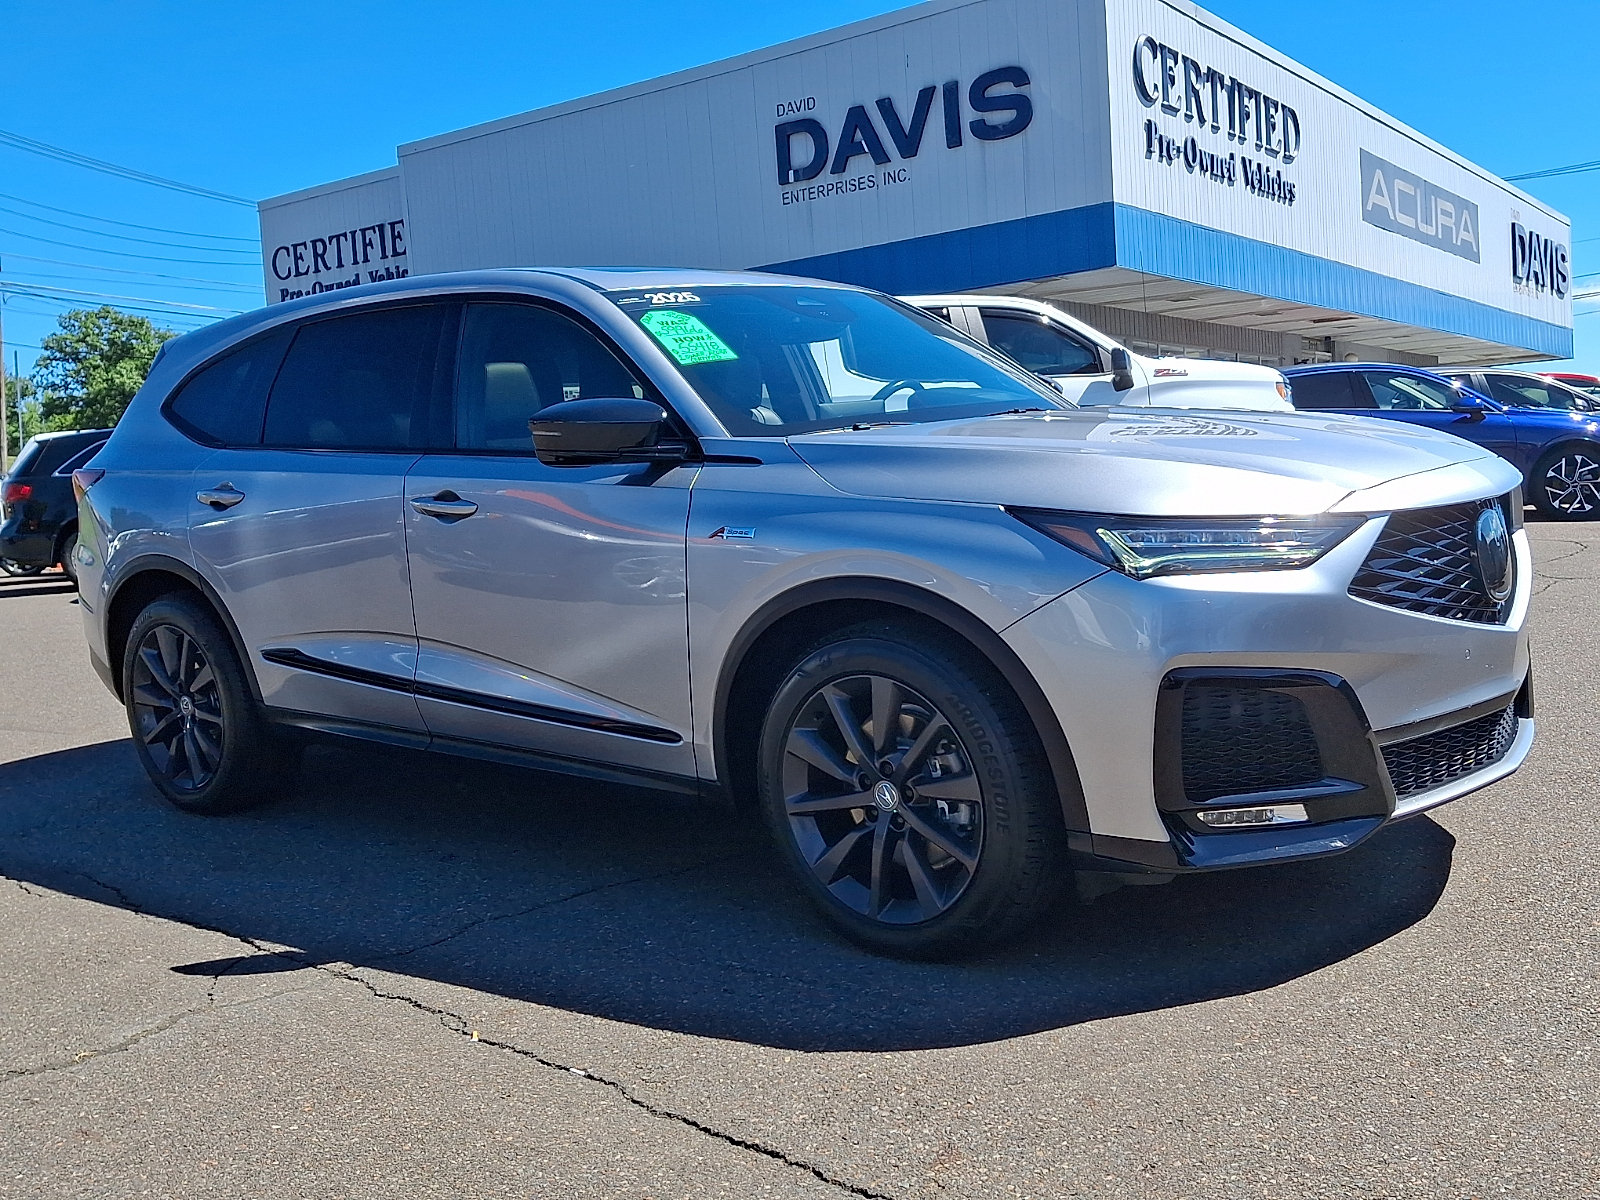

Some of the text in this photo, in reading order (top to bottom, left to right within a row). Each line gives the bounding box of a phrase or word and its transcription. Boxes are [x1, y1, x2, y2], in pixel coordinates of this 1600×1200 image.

[775, 66, 1033, 186] DAVIS
[776, 96, 816, 117] DAVID
[1133, 34, 1301, 163] CERTIFIED
[782, 168, 911, 205] ENTERPRISES, INC.
[1144, 119, 1297, 206] Pre-Owned Vehicles
[1366, 169, 1477, 252] ACURA
[272, 219, 407, 281] CERTIFIE
[368, 265, 409, 283] Vehic
[1511, 222, 1570, 299] DAVIS
